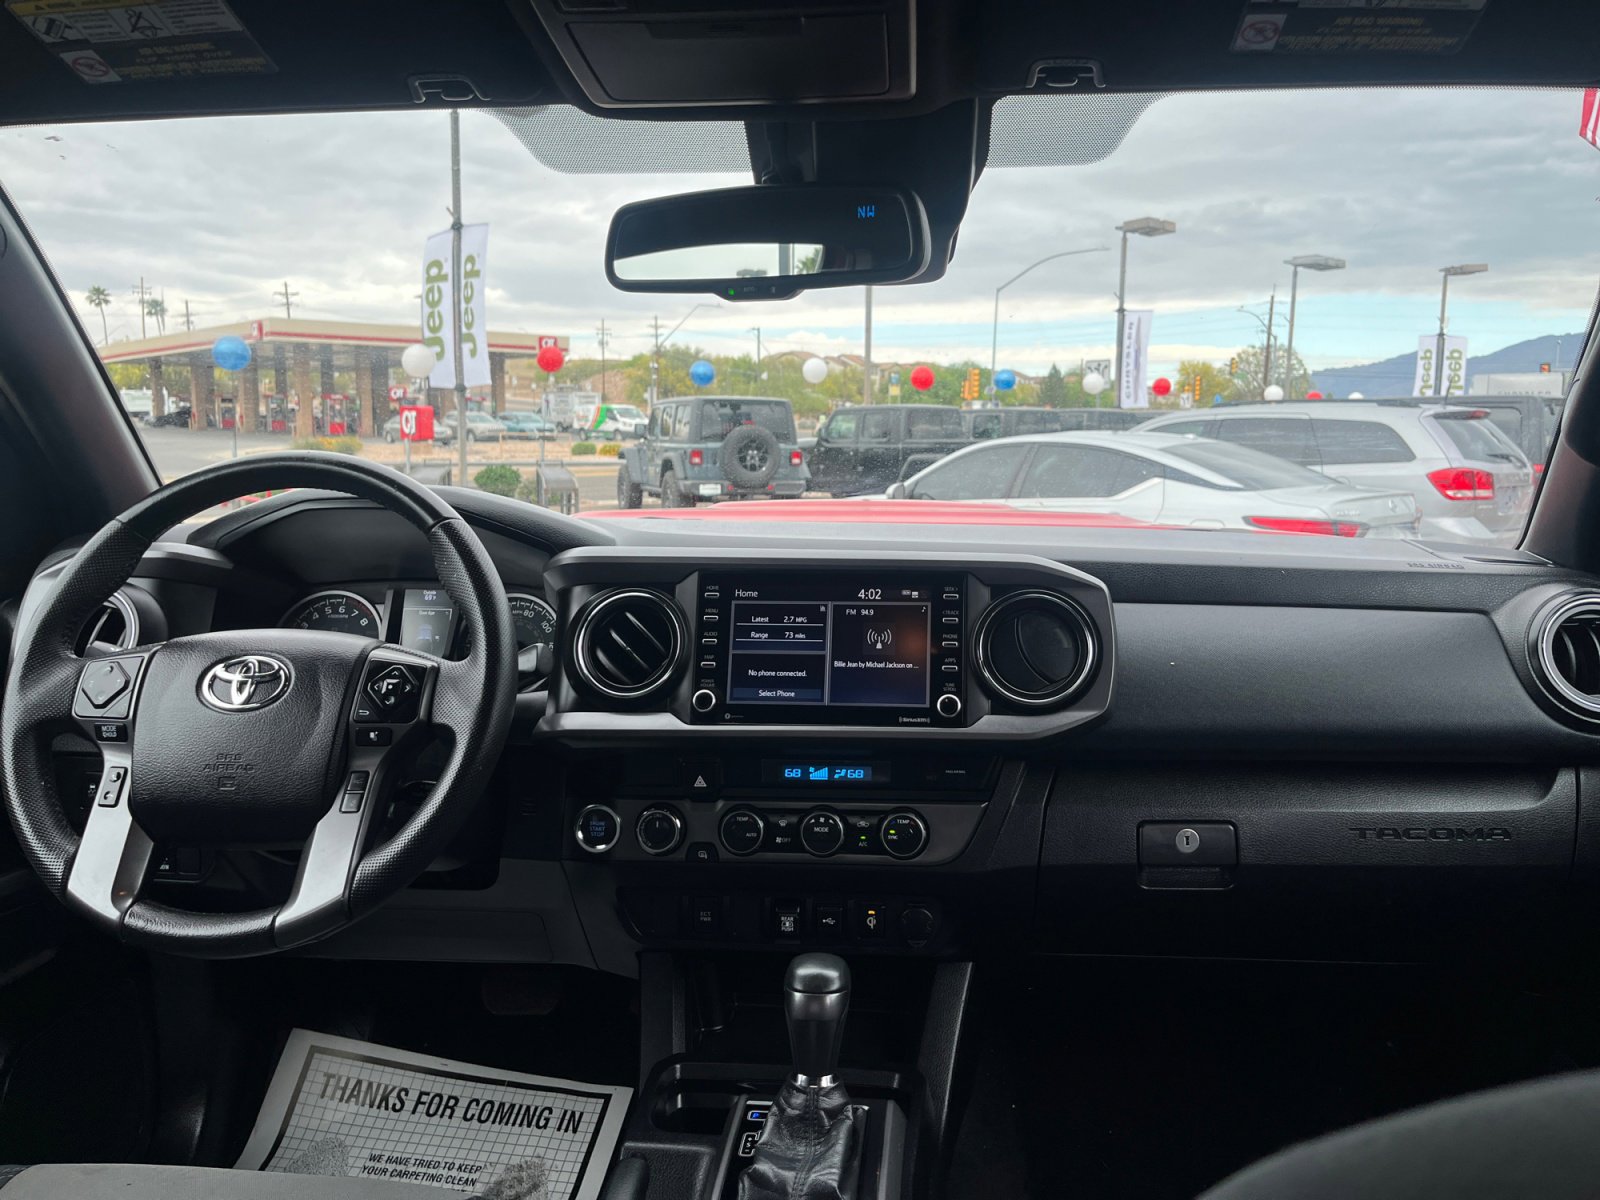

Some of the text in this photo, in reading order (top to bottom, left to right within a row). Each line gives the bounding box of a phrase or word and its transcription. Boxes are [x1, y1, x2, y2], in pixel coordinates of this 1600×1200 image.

[857, 205, 875, 218] NW
[425, 258, 448, 361] Jeep
[462, 254, 480, 358] Jeep
[402, 410, 417, 434] QT
[735, 589, 759, 598] Home
[858, 588, 882, 600] 4:02
[325, 606, 333, 614] 5
[338, 606, 346, 614] 6
[351, 609, 359, 617] 7
[523, 609, 535, 618] 80
[312, 612, 320, 620] 4
[360, 617, 369, 627] 8
[541, 620, 553, 634] 100
[750, 632, 769, 640] Range
[758, 689, 776, 697] Select
[784, 768, 802, 778] 68
[847, 768, 864, 779] 68
[1349, 827, 1512, 842] TACOMA
[320, 1072, 584, 1134] THANKS FOR COMING IN
[369, 1153, 482, 1174] WE HAVE TRIED TO KEEP
[361, 1165, 478, 1187] YOUR CARPETING CLEAN
